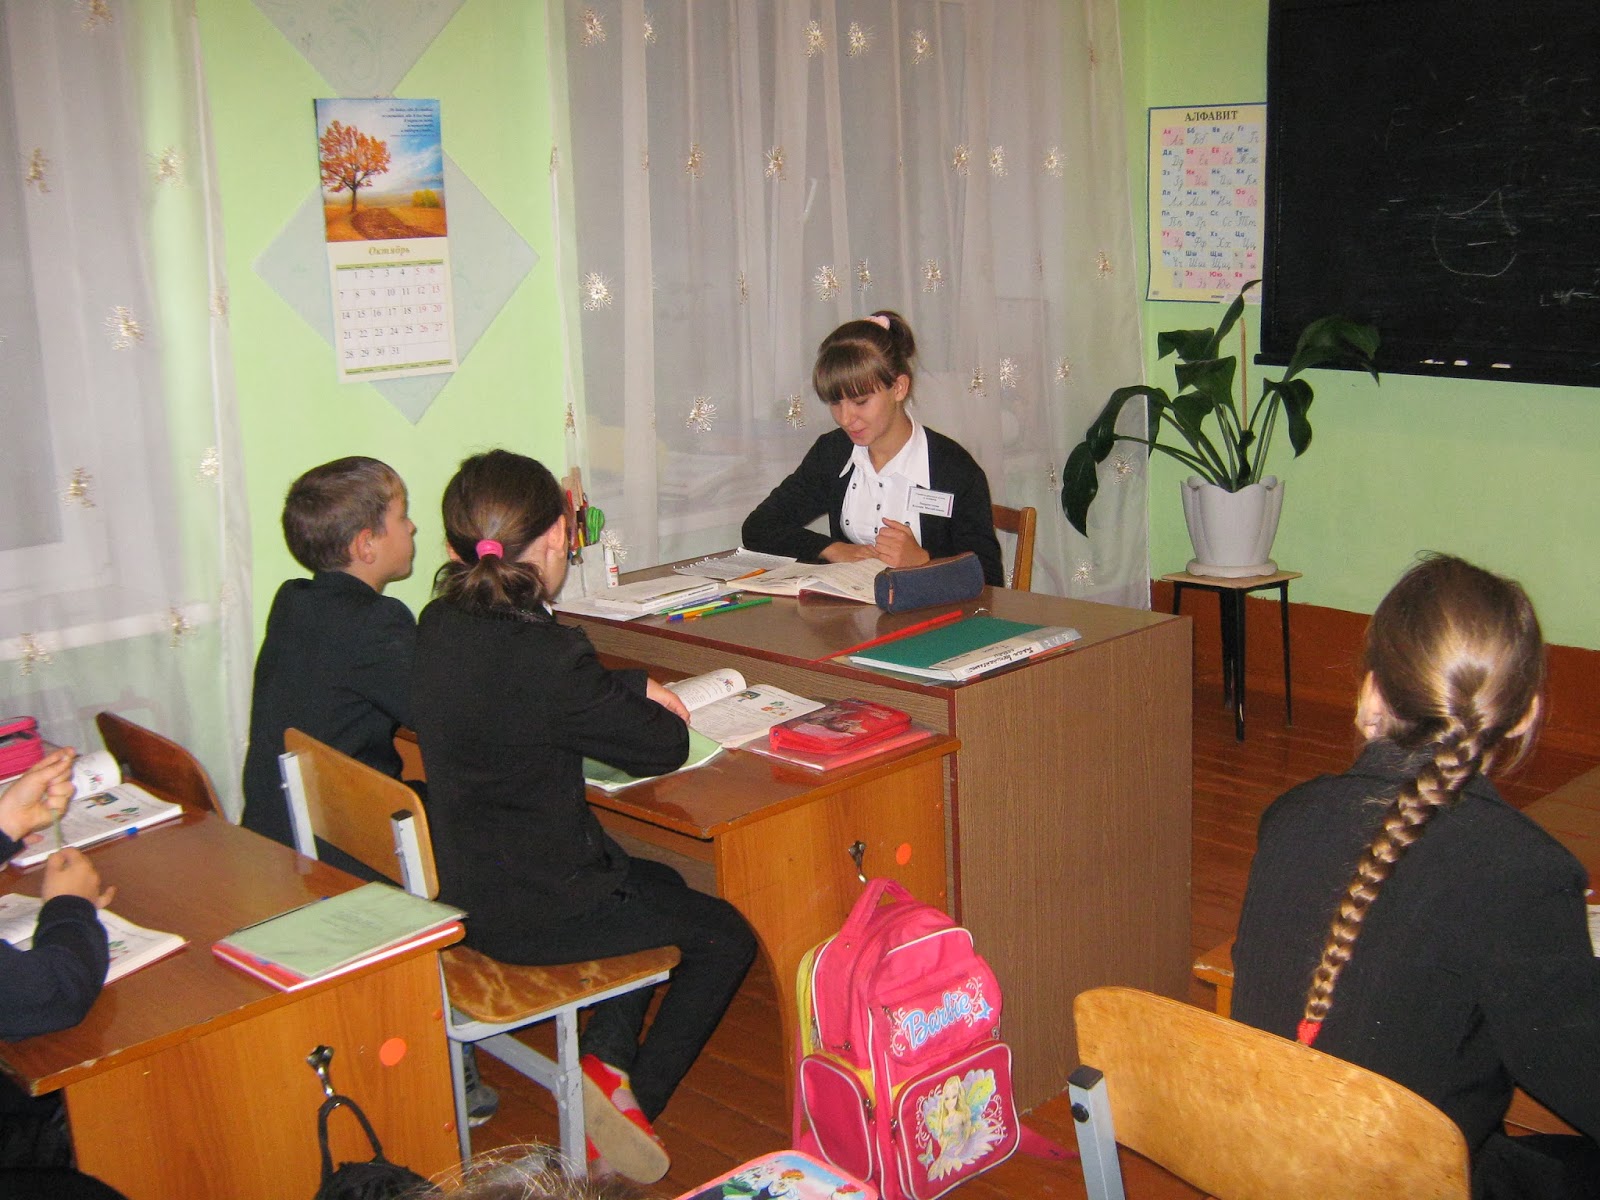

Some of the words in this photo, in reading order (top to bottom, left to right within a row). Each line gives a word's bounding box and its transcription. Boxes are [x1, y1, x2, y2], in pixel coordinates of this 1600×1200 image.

[1185, 111, 1238, 121] АЛФАВИТ
[369, 246, 410, 256] Октябрь
[901, 991, 971, 1050] Barbie
